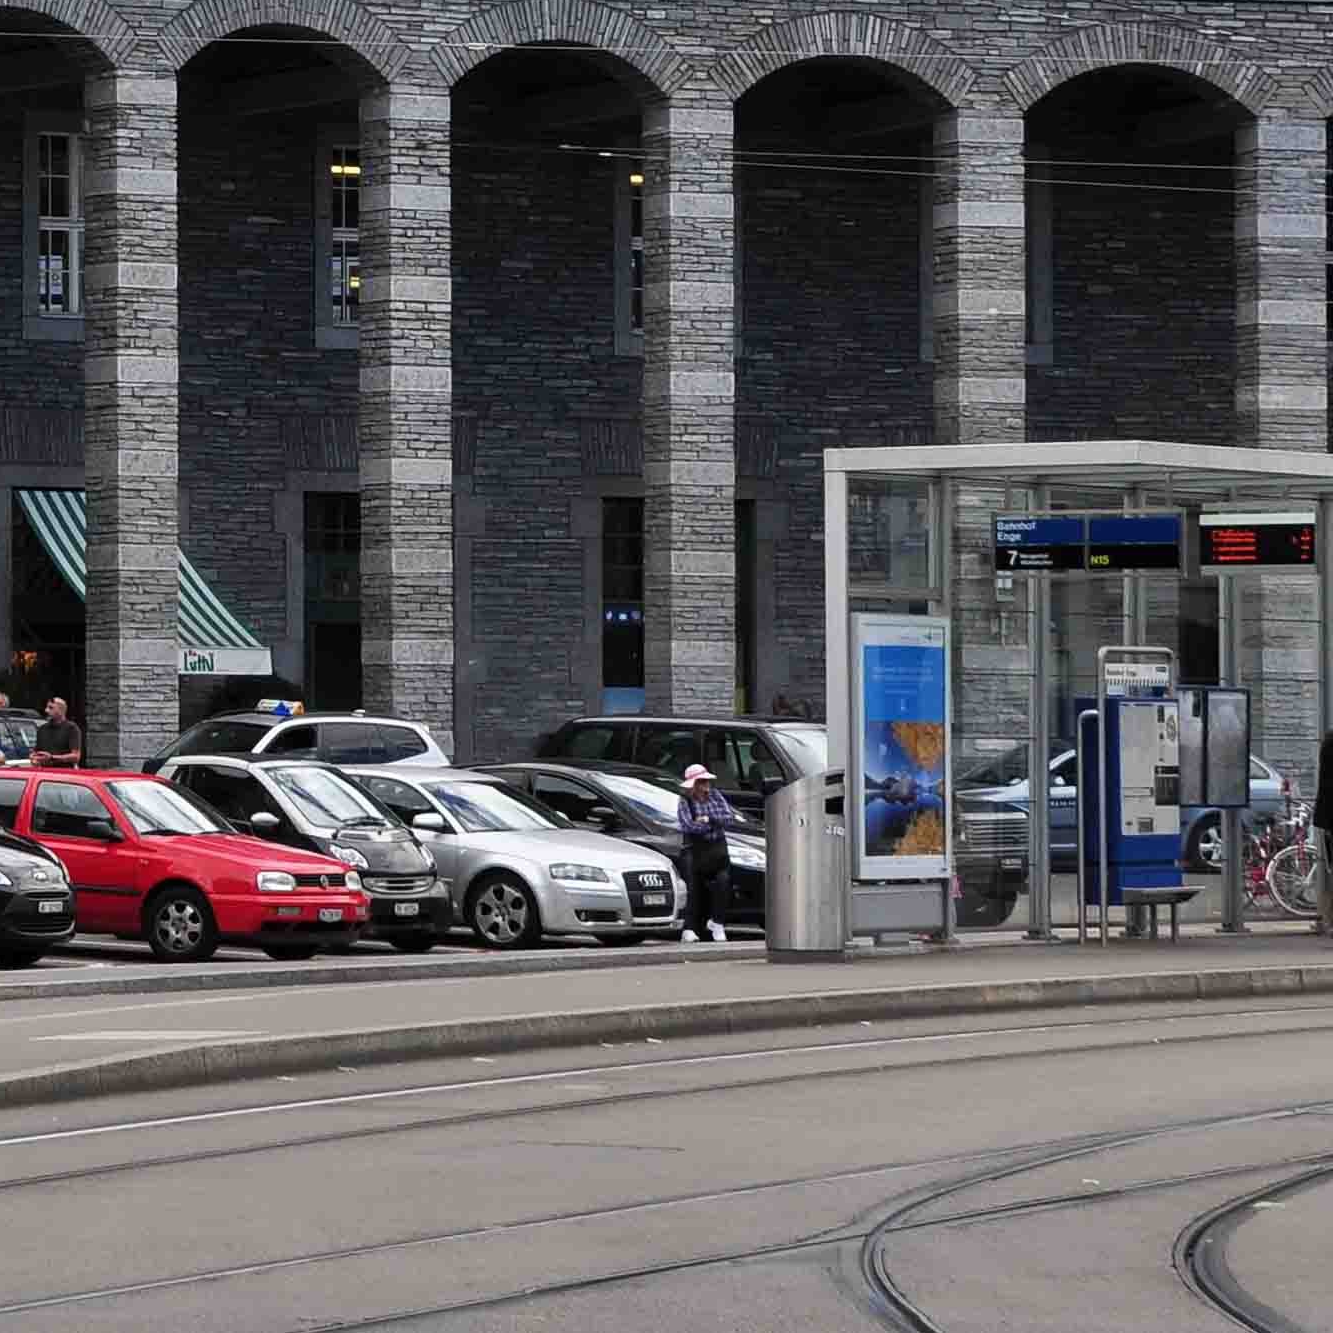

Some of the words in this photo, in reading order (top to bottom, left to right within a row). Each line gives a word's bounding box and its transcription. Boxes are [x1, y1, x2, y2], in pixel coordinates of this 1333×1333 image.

[996, 521, 1037, 531] Bahnhof
[996, 532, 1022, 542] Enge
[1006, 550, 1018, 566] 7
